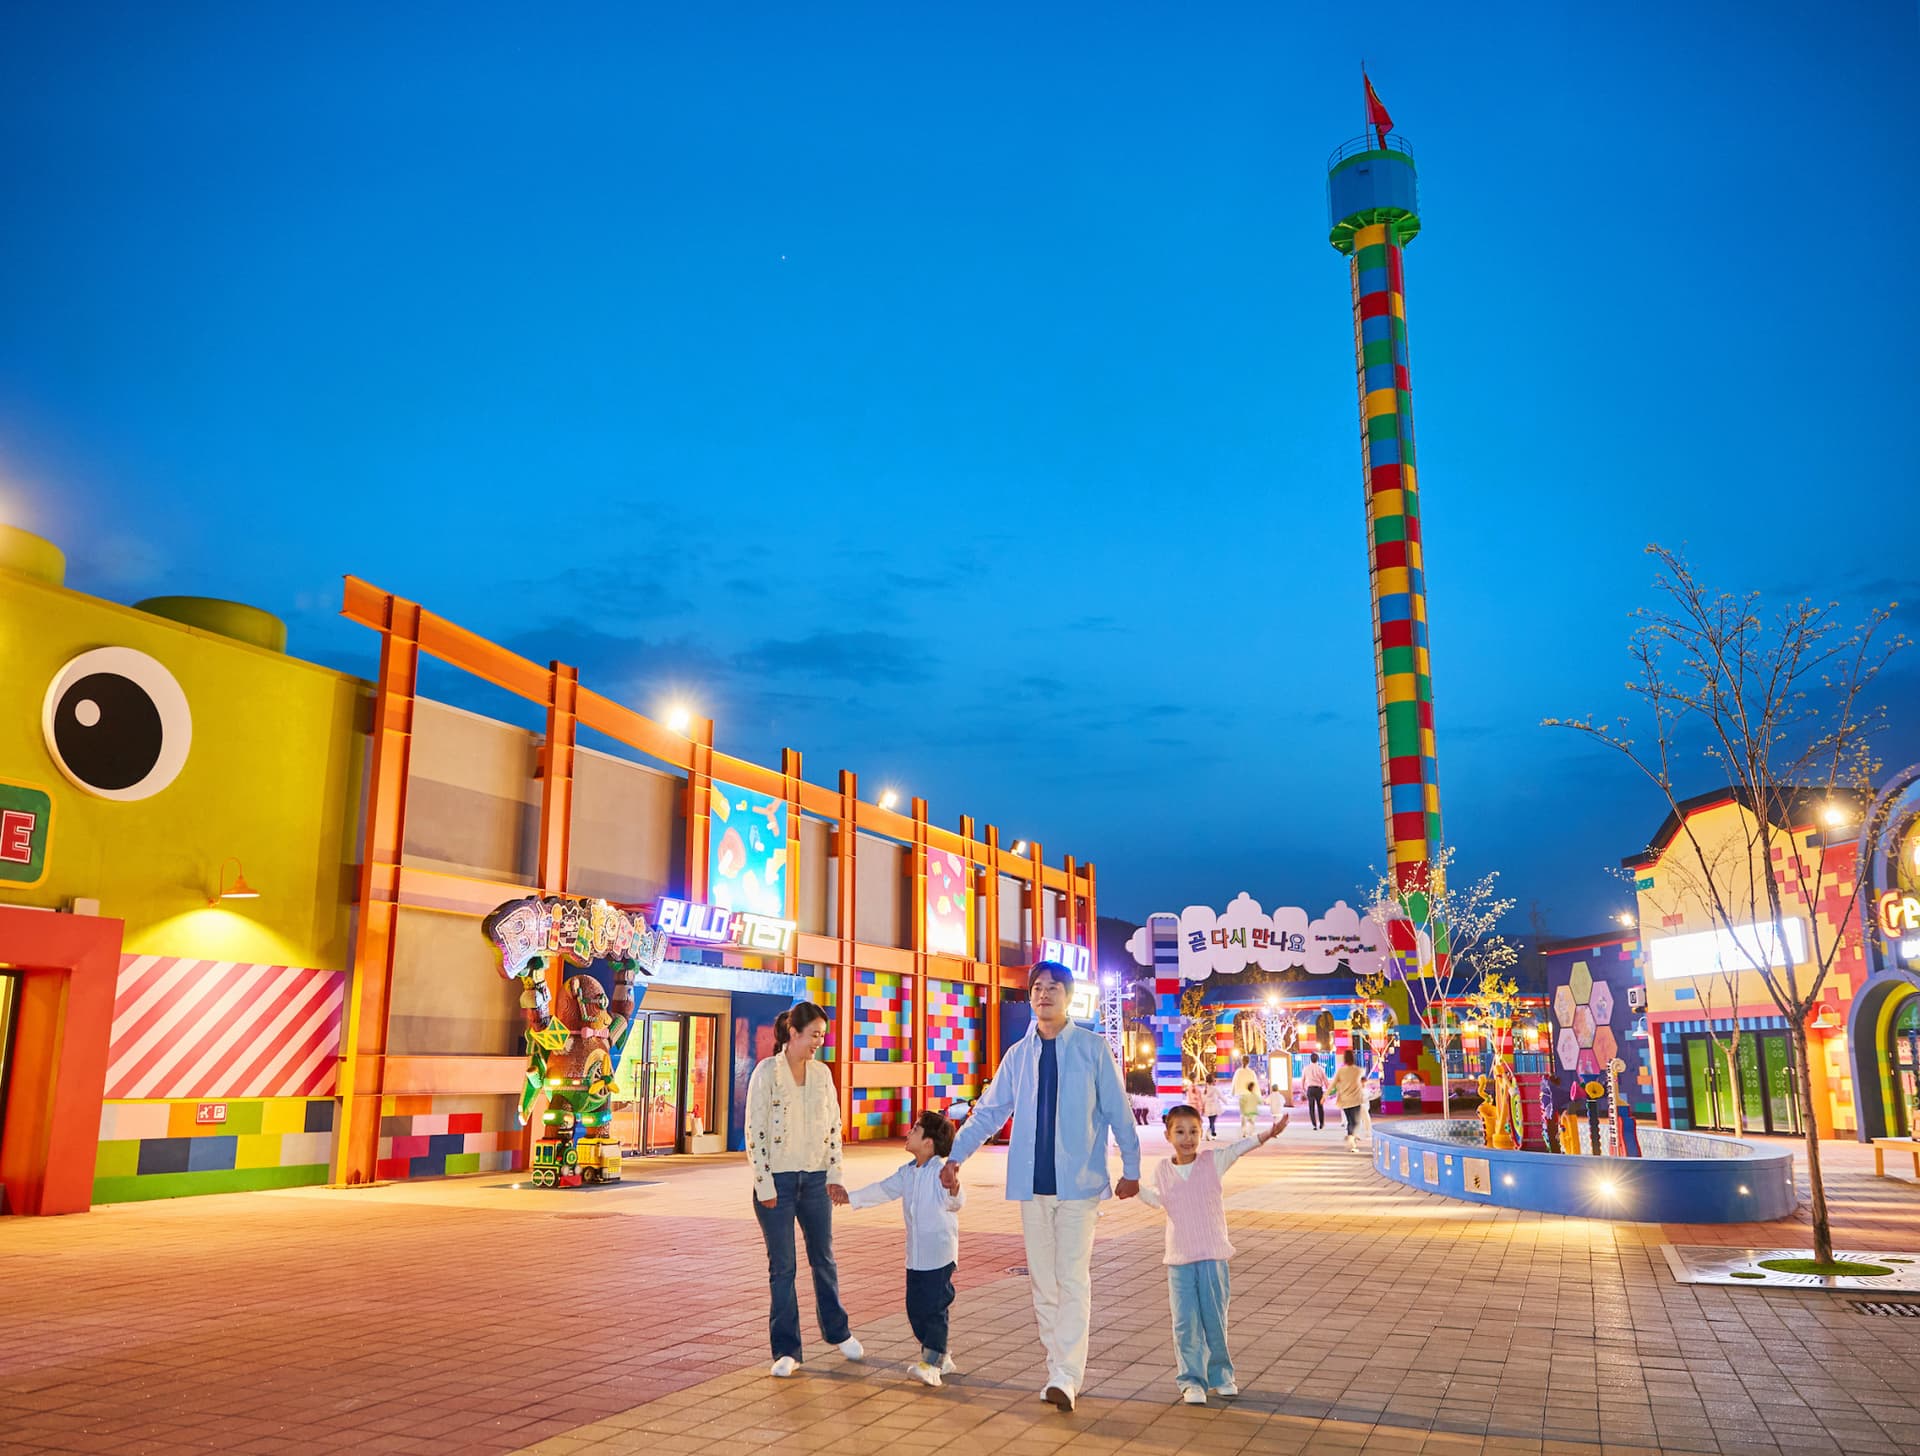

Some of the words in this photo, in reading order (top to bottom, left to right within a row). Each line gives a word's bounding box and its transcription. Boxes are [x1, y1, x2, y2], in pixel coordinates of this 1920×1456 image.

[1188, 930, 1207, 953] 곧
[1211, 927, 1247, 949] 다시
[1252, 928, 1306, 952] 만나요
